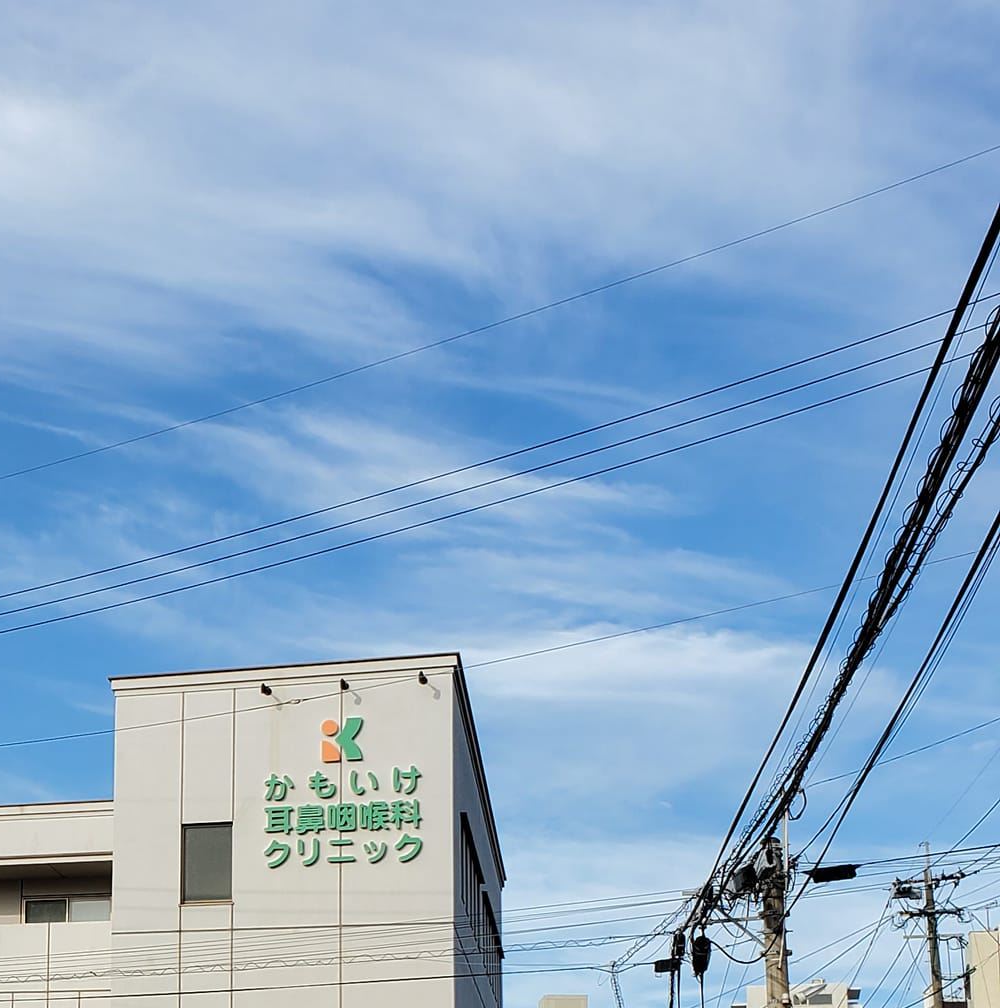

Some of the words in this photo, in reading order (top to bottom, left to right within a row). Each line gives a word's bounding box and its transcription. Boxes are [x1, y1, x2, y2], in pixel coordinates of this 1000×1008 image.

[264, 765, 422, 801] かもいけ
[264, 799, 423, 835] 耳鼻咽喉科
[264, 833, 423, 868] クリニック
